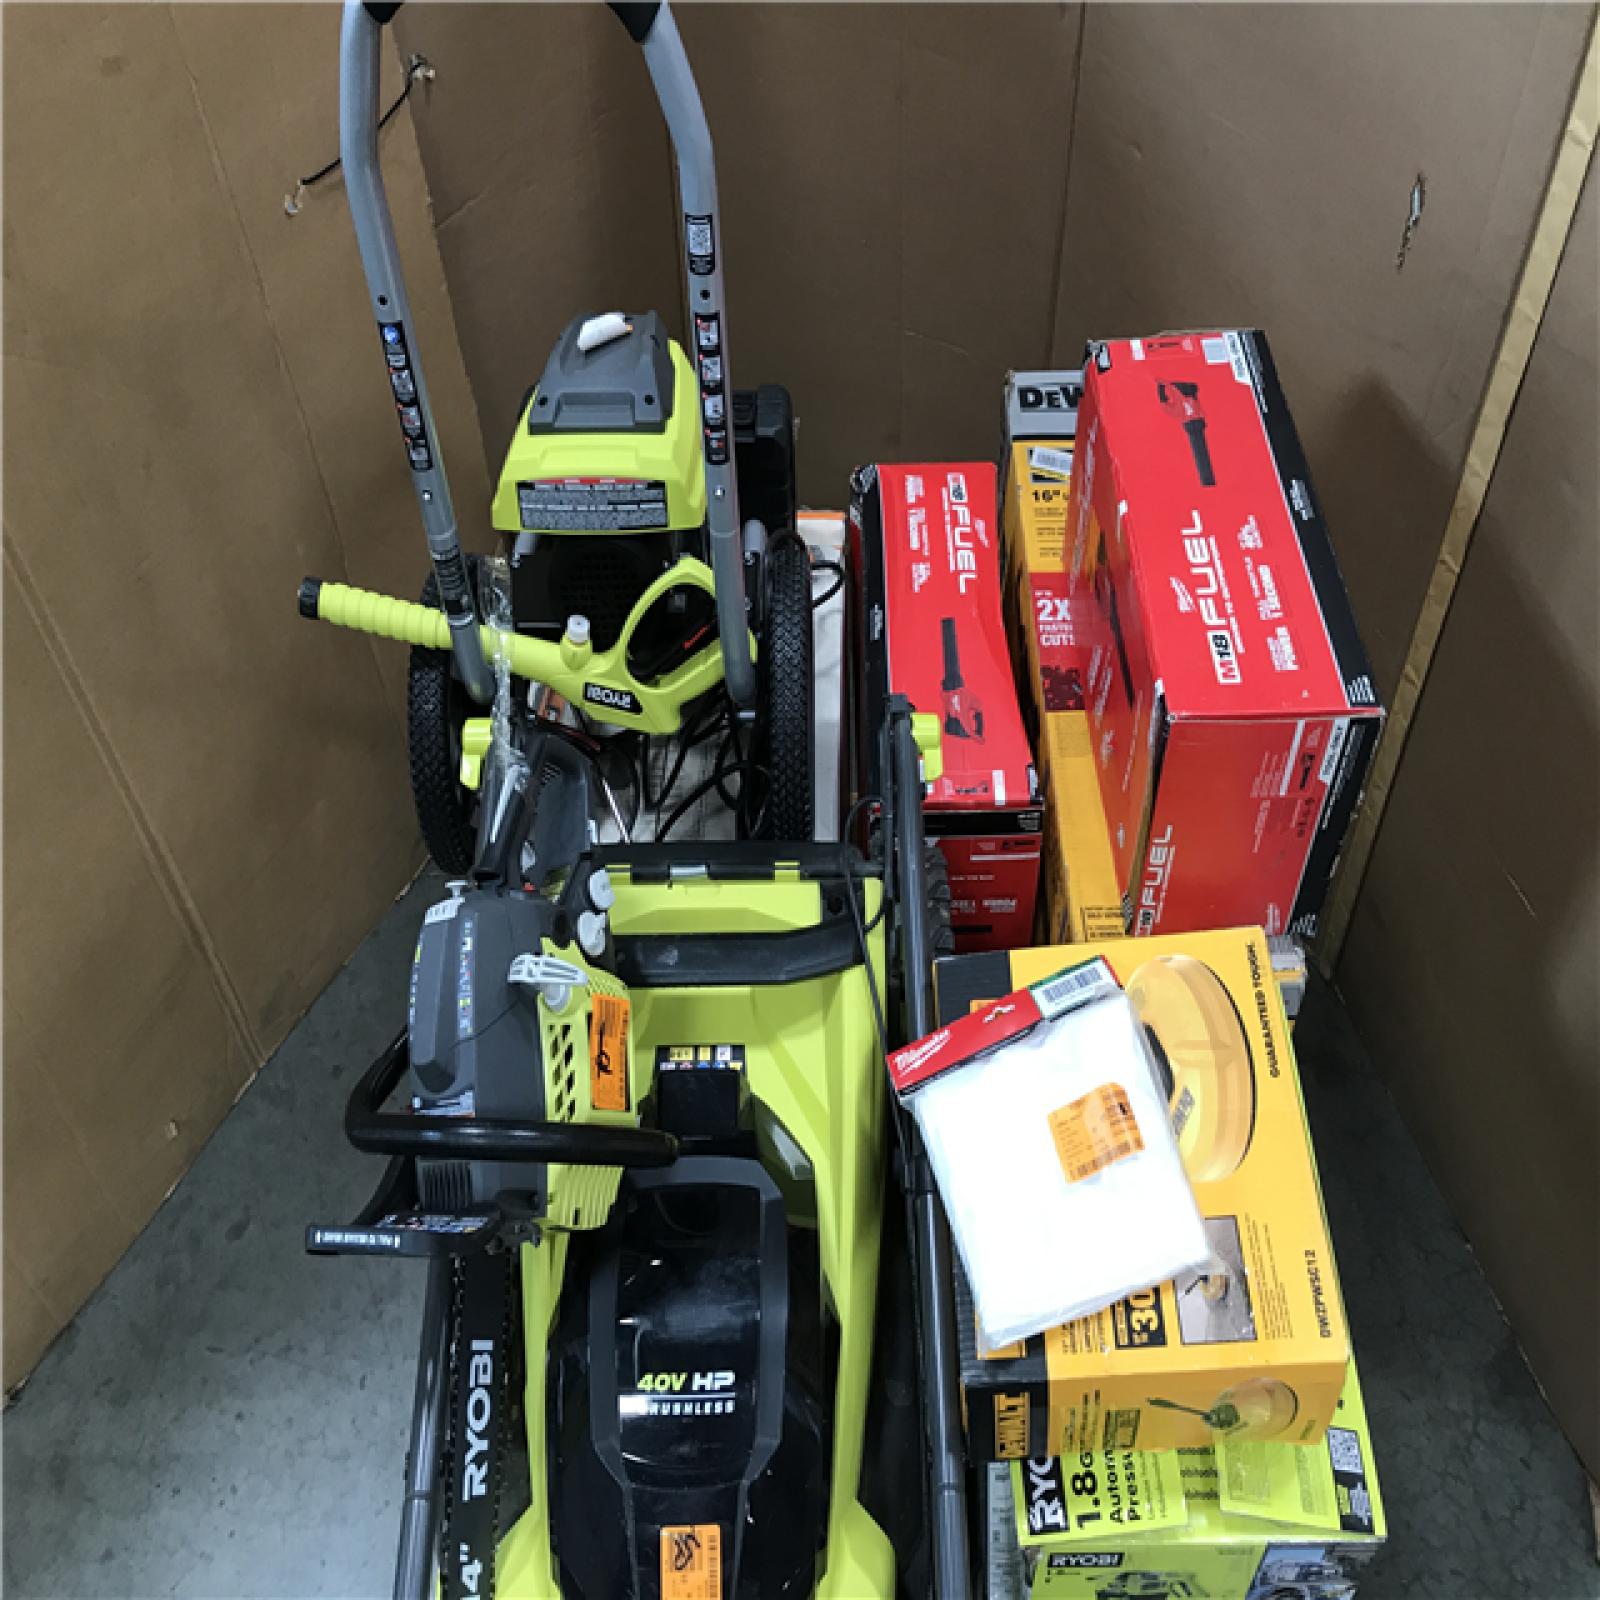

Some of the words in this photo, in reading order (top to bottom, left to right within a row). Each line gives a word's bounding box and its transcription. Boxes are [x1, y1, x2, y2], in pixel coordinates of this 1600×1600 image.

[951, 504, 977, 594] FUEL
[1180, 509, 1228, 626] FUEL
[1036, 598, 1071, 621] 2X
[1206, 628, 1242, 685] M18
[1141, 824, 1174, 906] FUEL
[463, 1339, 494, 1501] RYOBI
[637, 1371, 688, 1391] 40V
[692, 1370, 736, 1391] HP
